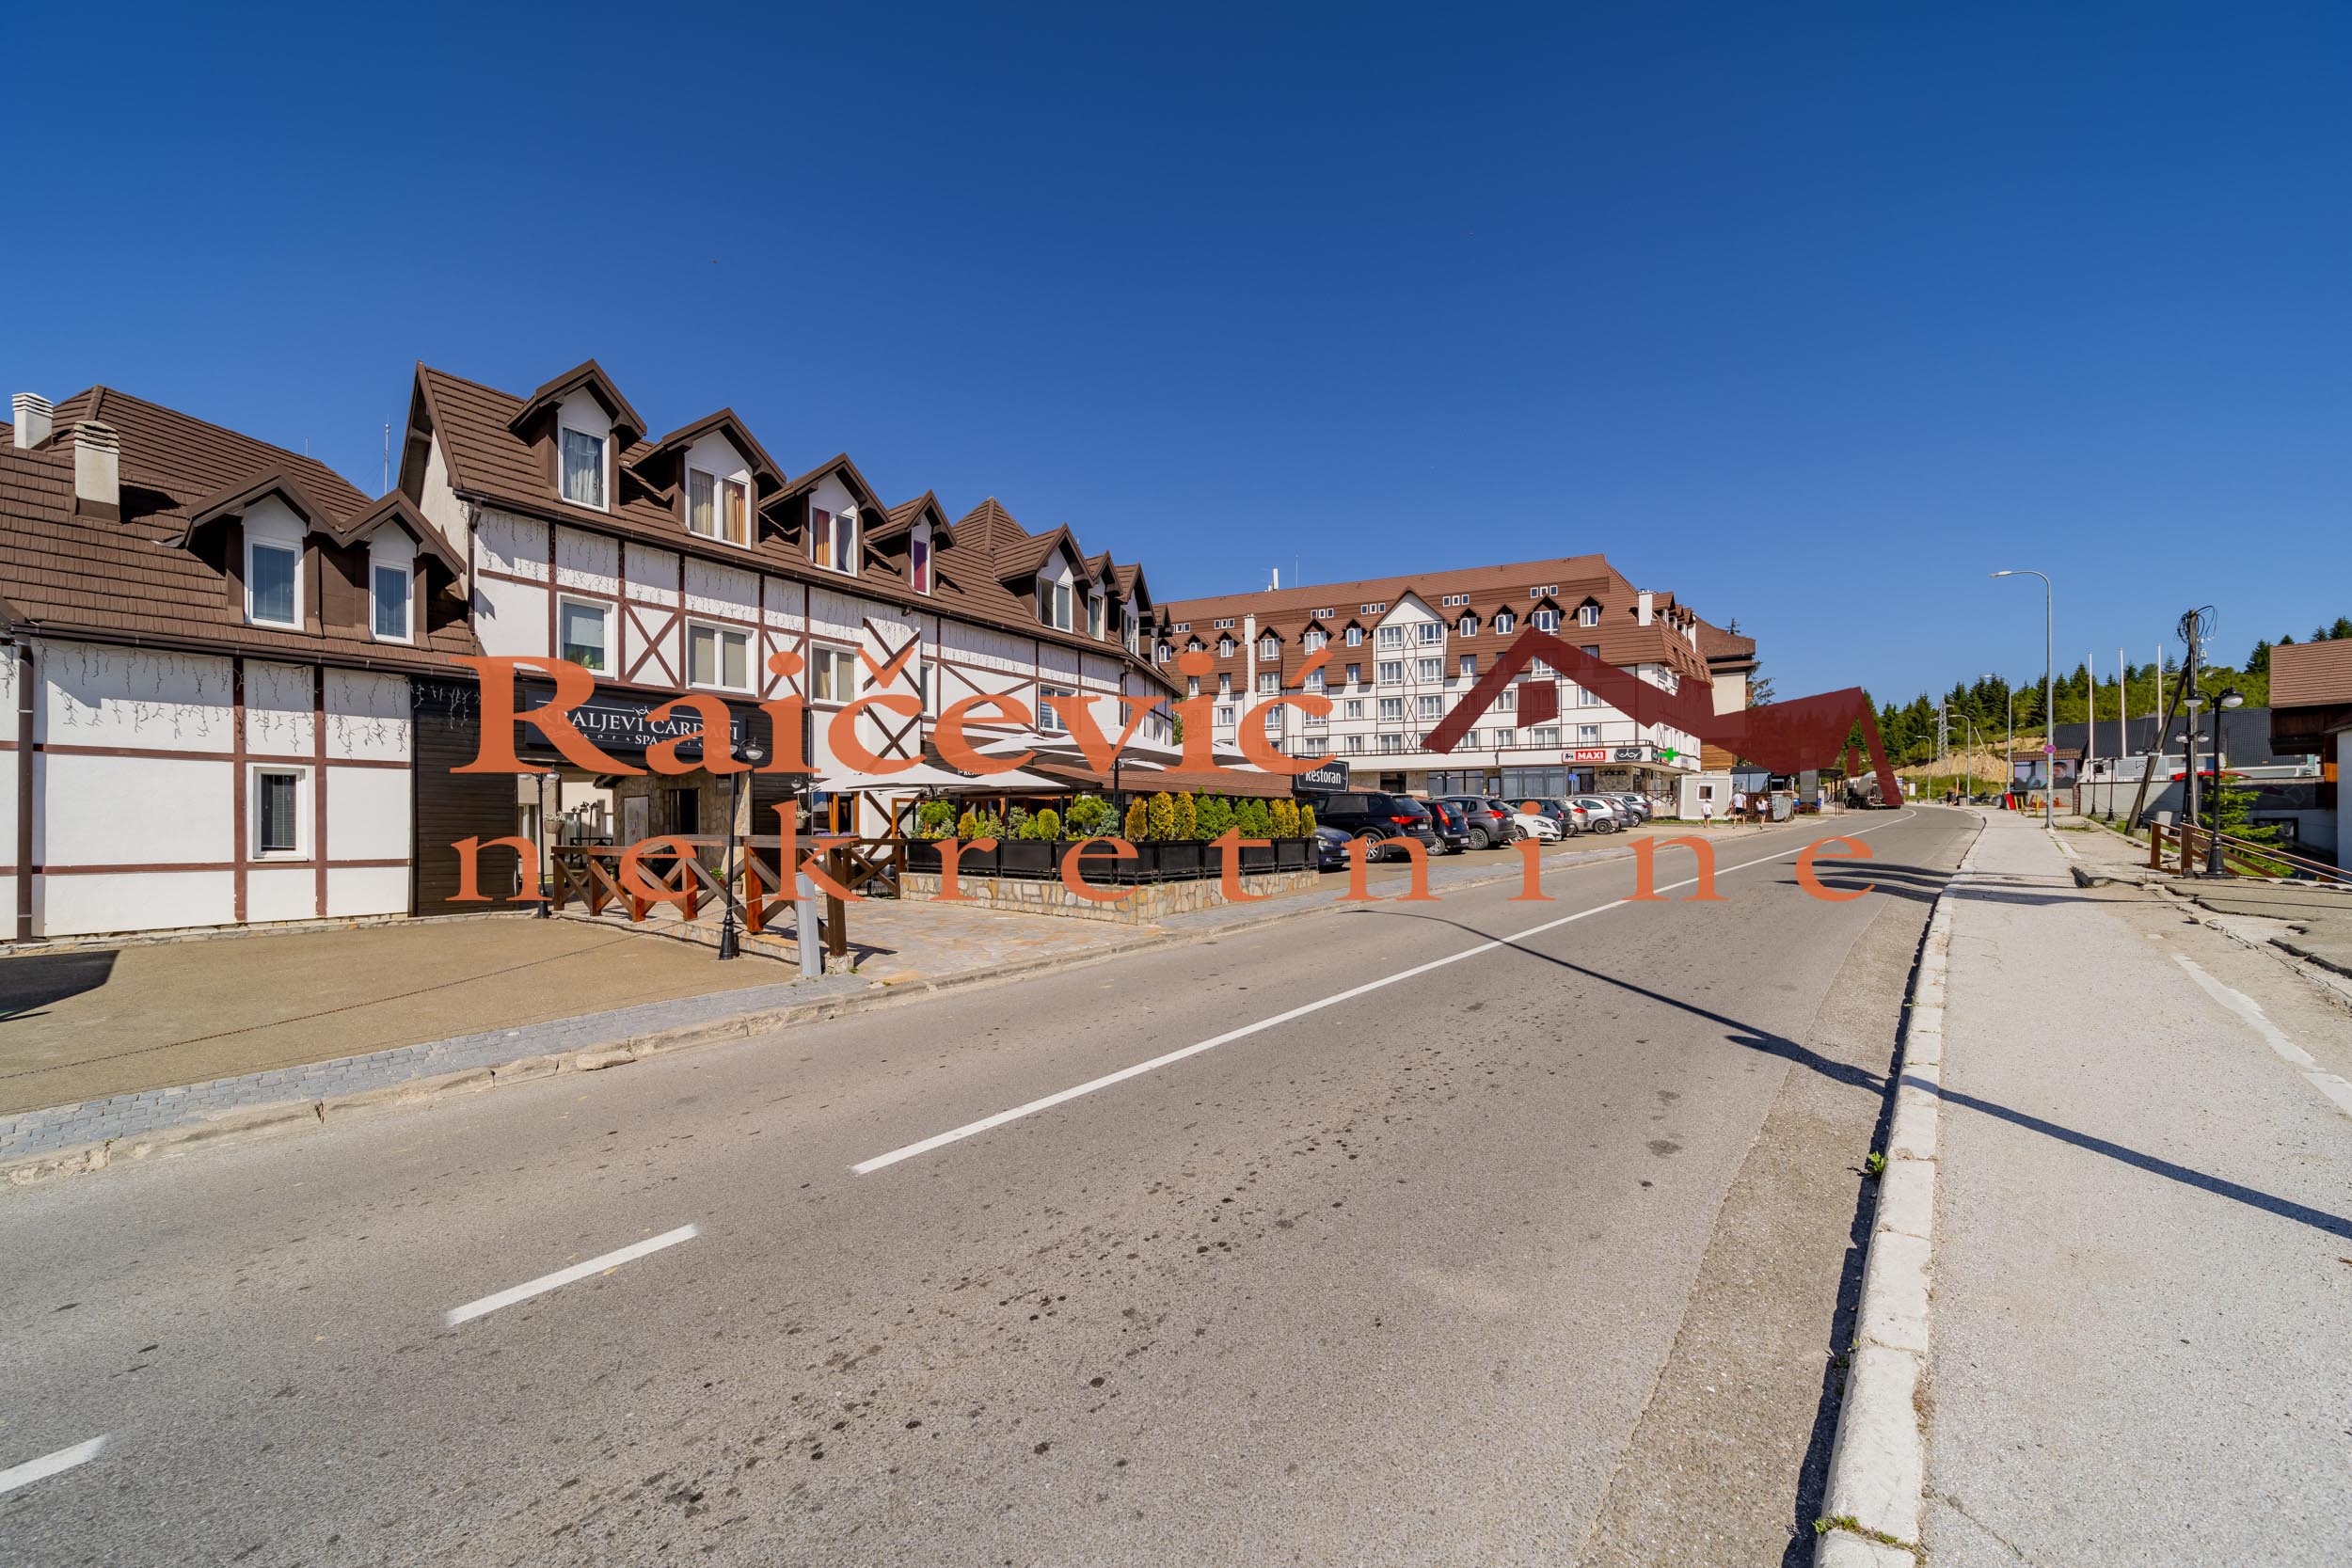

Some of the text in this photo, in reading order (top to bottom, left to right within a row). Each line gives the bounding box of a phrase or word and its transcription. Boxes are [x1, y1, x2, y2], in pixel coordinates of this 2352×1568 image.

[634, 734, 659, 745] SPA
[1578, 752, 1604, 760] MAXI
[1305, 768, 1341, 784] Restoran
